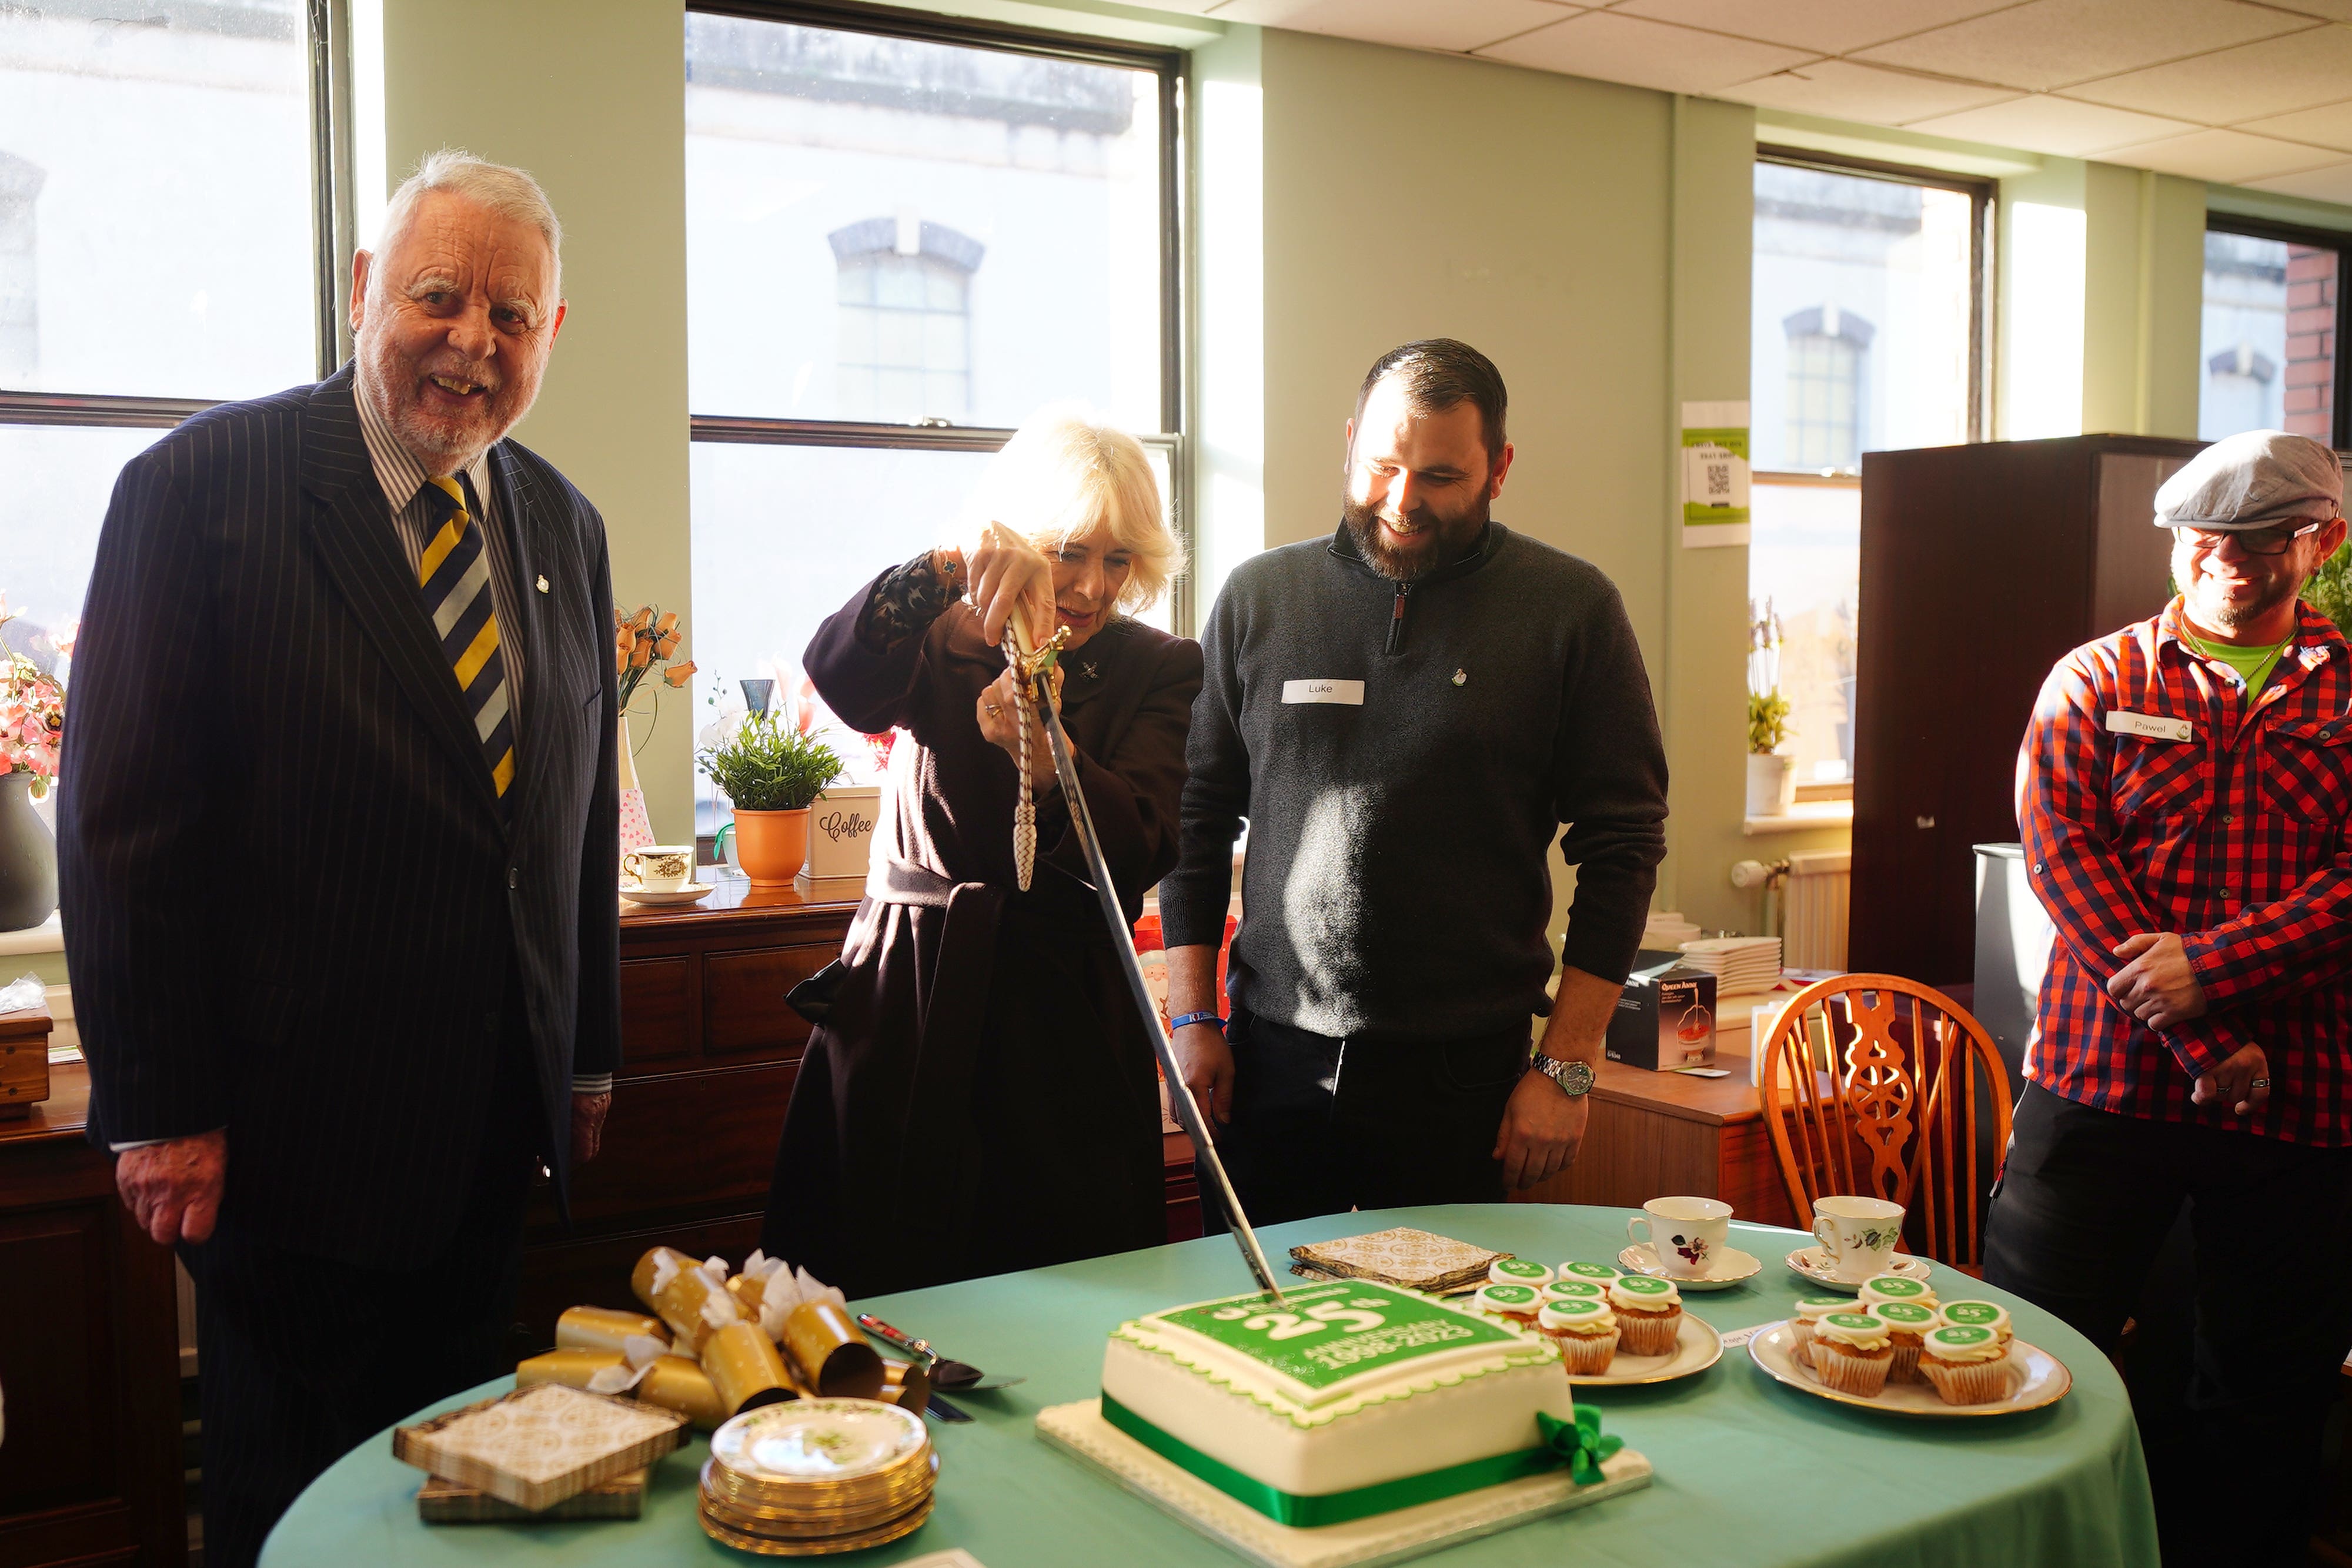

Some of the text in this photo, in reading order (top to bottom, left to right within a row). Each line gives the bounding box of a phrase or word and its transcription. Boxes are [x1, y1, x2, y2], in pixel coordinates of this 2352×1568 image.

[1309, 684, 1333, 693] Luke
[2134, 721, 2166, 733] Pawel
[819, 811, 873, 842] Coffee
[1662, 982, 1681, 991] QUEEN
